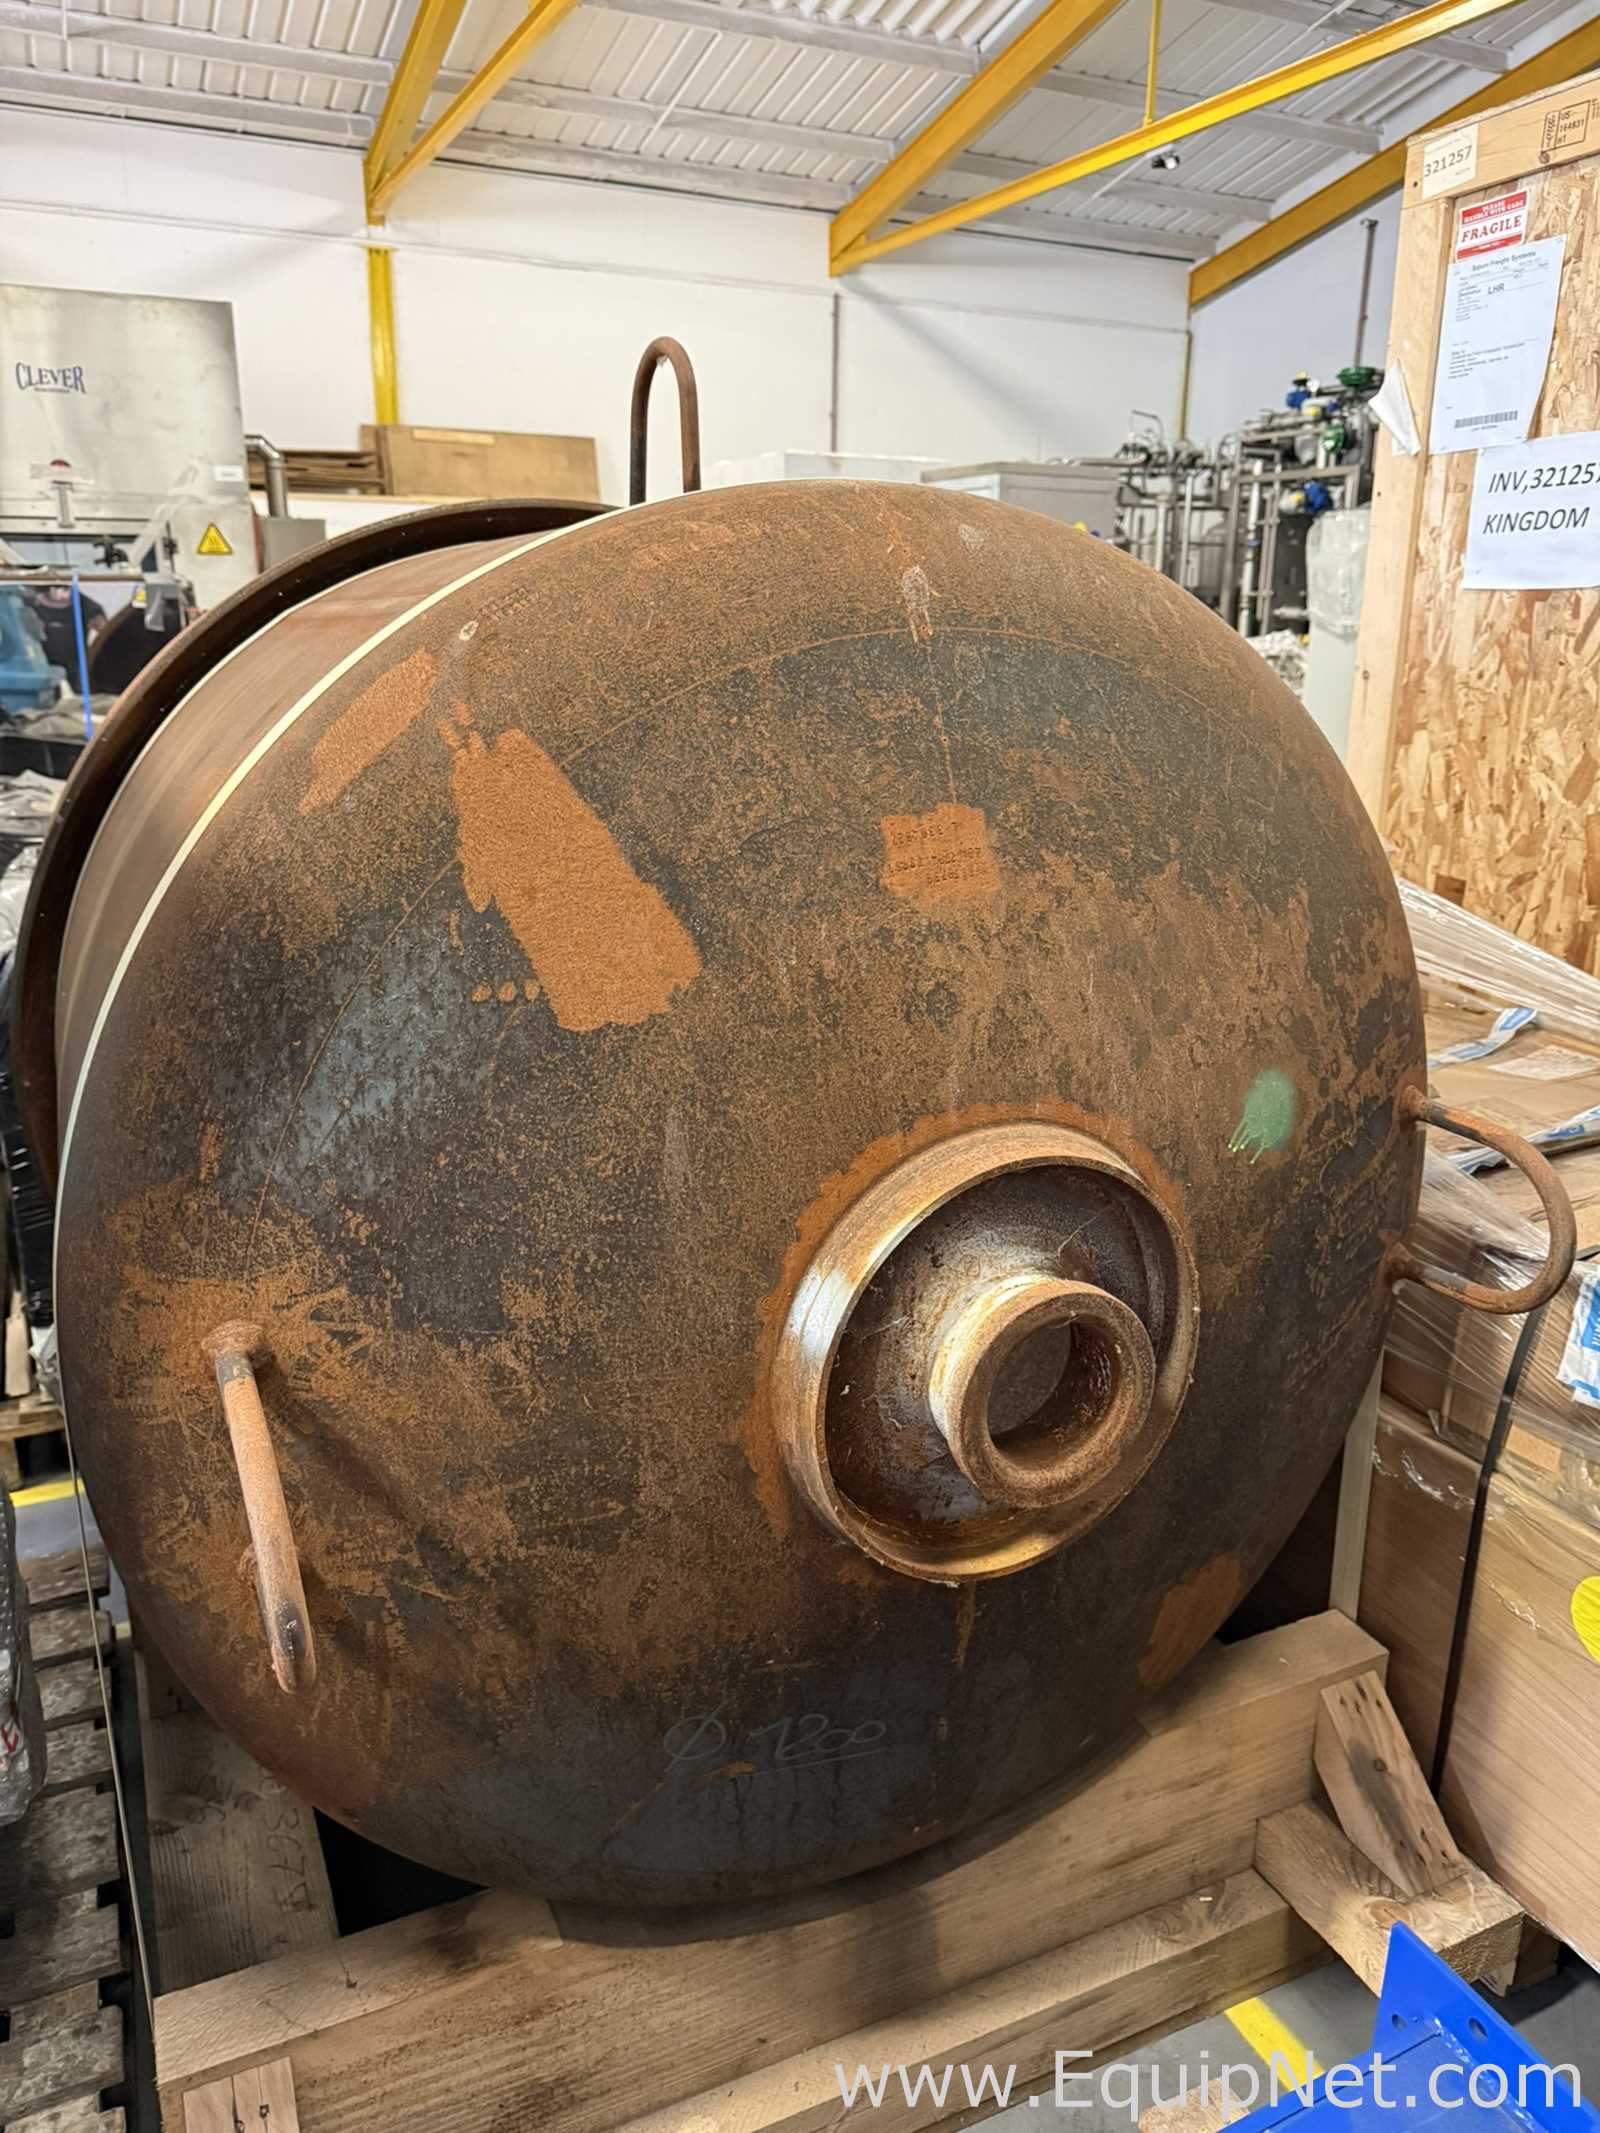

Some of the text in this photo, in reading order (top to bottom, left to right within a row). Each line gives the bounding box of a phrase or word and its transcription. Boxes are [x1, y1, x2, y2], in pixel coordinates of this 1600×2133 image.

[1423, 145, 1472, 178] 321257
[1462, 215, 1522, 242] FRAGILE
[15, 362, 87, 394] CLEVER
[1488, 462, 1600, 495] INV,32125
[1482, 507, 1590, 534] KINGDOM
[750, 1712, 887, 1761] 1200
